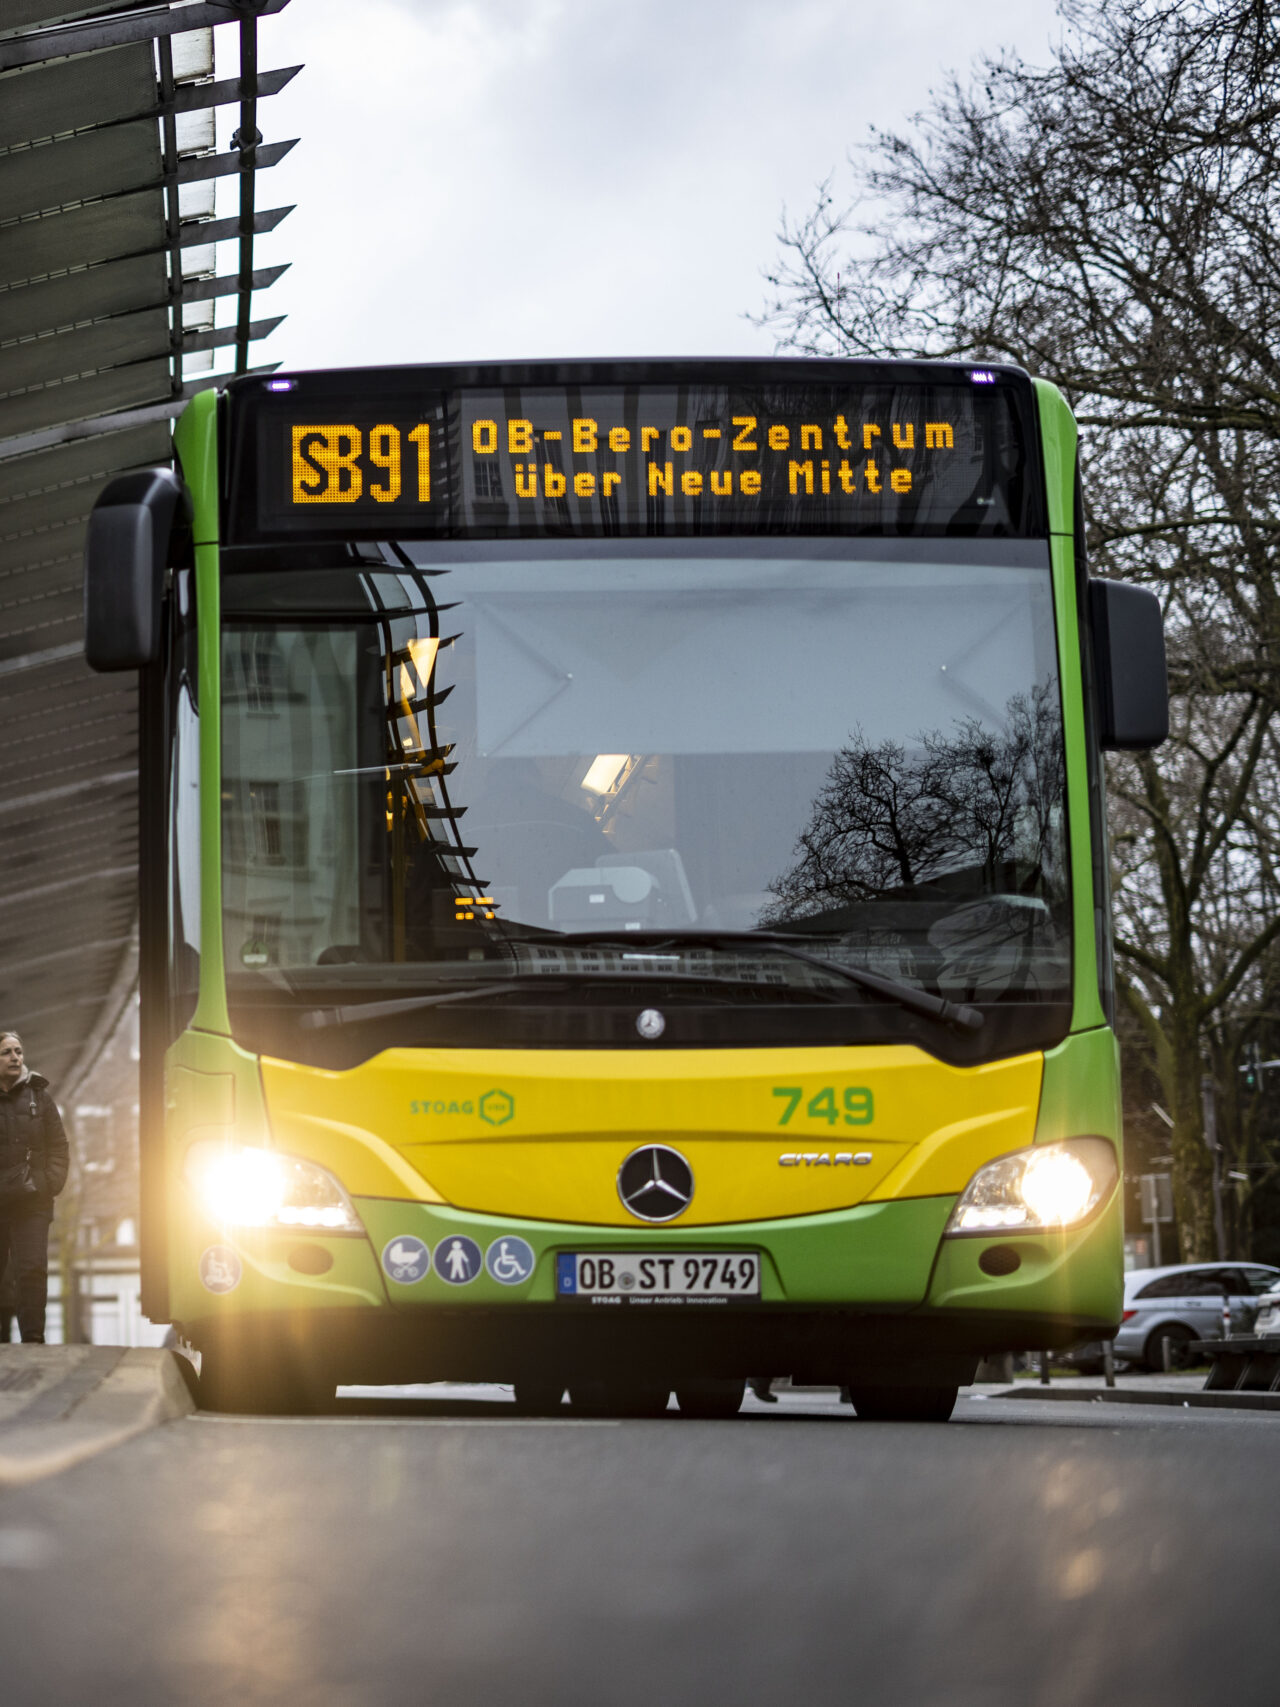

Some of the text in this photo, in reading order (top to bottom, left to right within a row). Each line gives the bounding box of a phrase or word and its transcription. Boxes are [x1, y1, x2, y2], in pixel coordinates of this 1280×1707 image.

[472, 415, 955, 454] OB-Bero-Zentrum
[292, 424, 430, 503] SB91
[515, 459, 913, 498] über Neue Mitte
[410, 1100, 473, 1115] STOAG
[773, 1087, 874, 1125] 749
[778, 1152, 873, 1167] CITARO
[564, 1277, 571, 1287] D
[580, 1259, 755, 1289] OB ST 9749
[591, 1296, 621, 1304] STOAG
[629, 1296, 653, 1304] Unser
